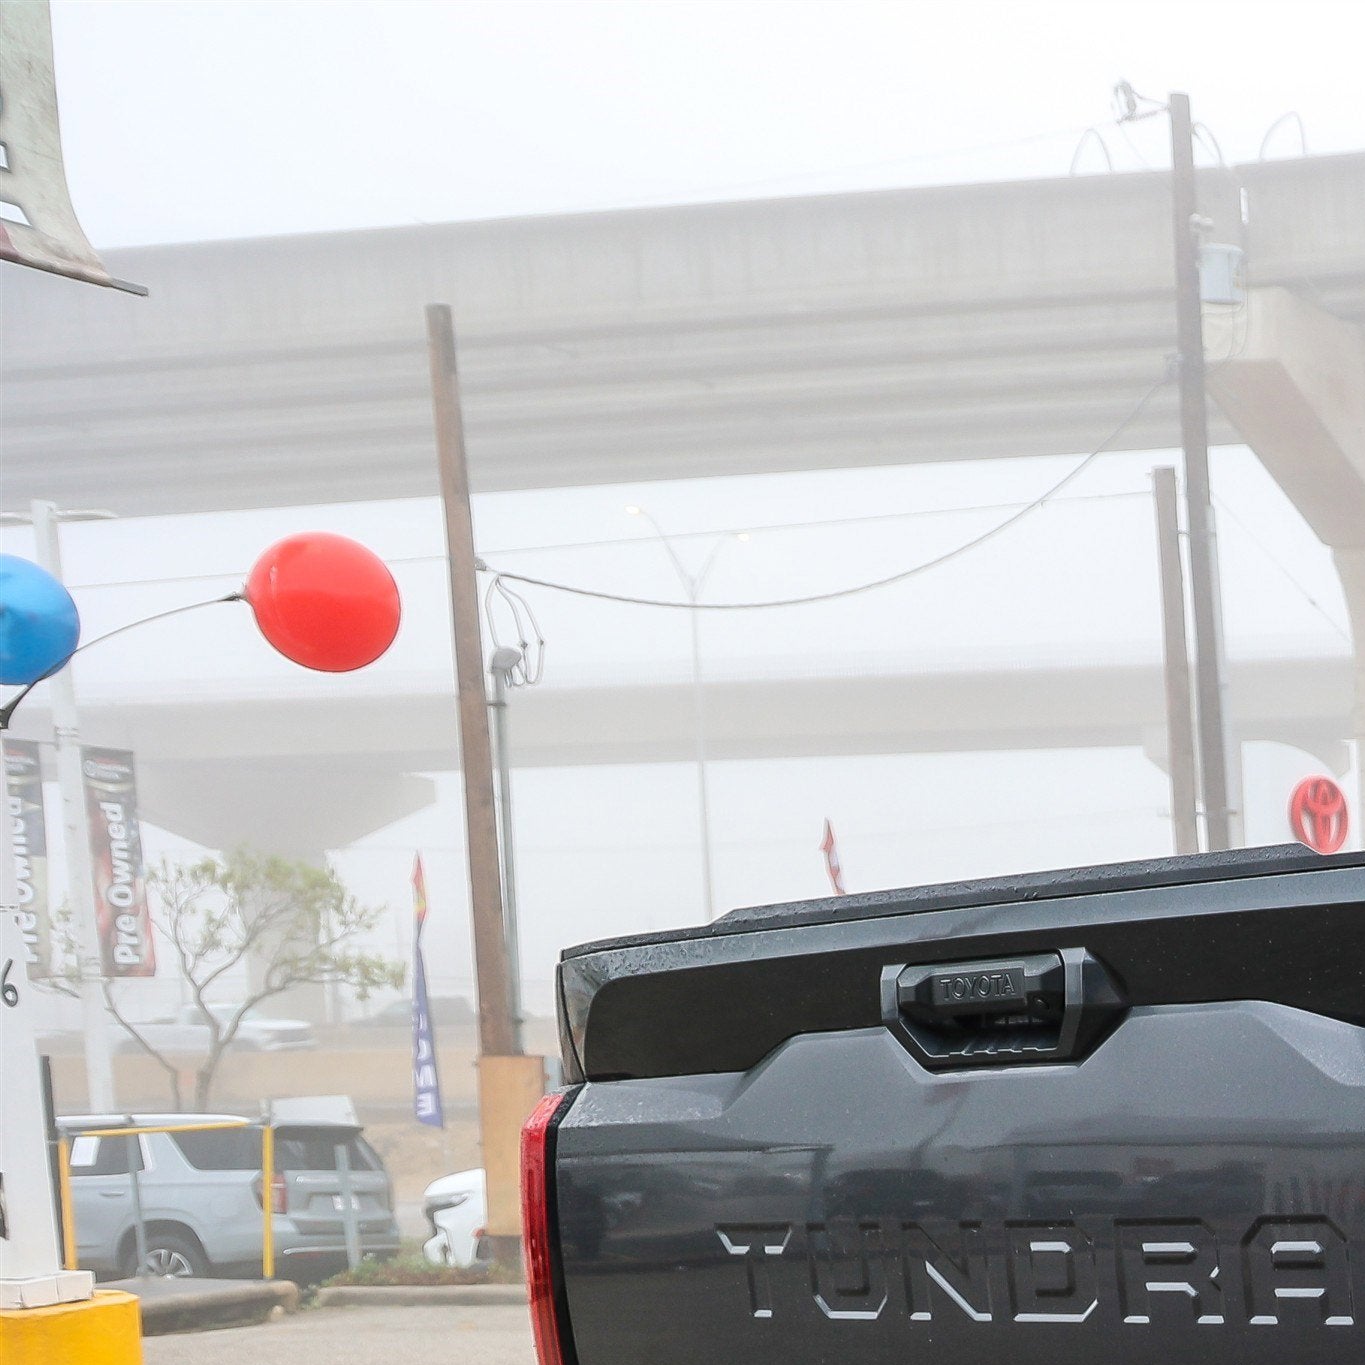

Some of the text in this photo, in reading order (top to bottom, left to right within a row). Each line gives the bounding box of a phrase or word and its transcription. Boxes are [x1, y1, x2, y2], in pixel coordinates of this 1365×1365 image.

[100, 801, 134, 907] Owned
[113, 912, 140, 965] Pre
[940, 973, 1015, 999] TOYOTA
[714, 1213, 1355, 1325] TUNDRA
